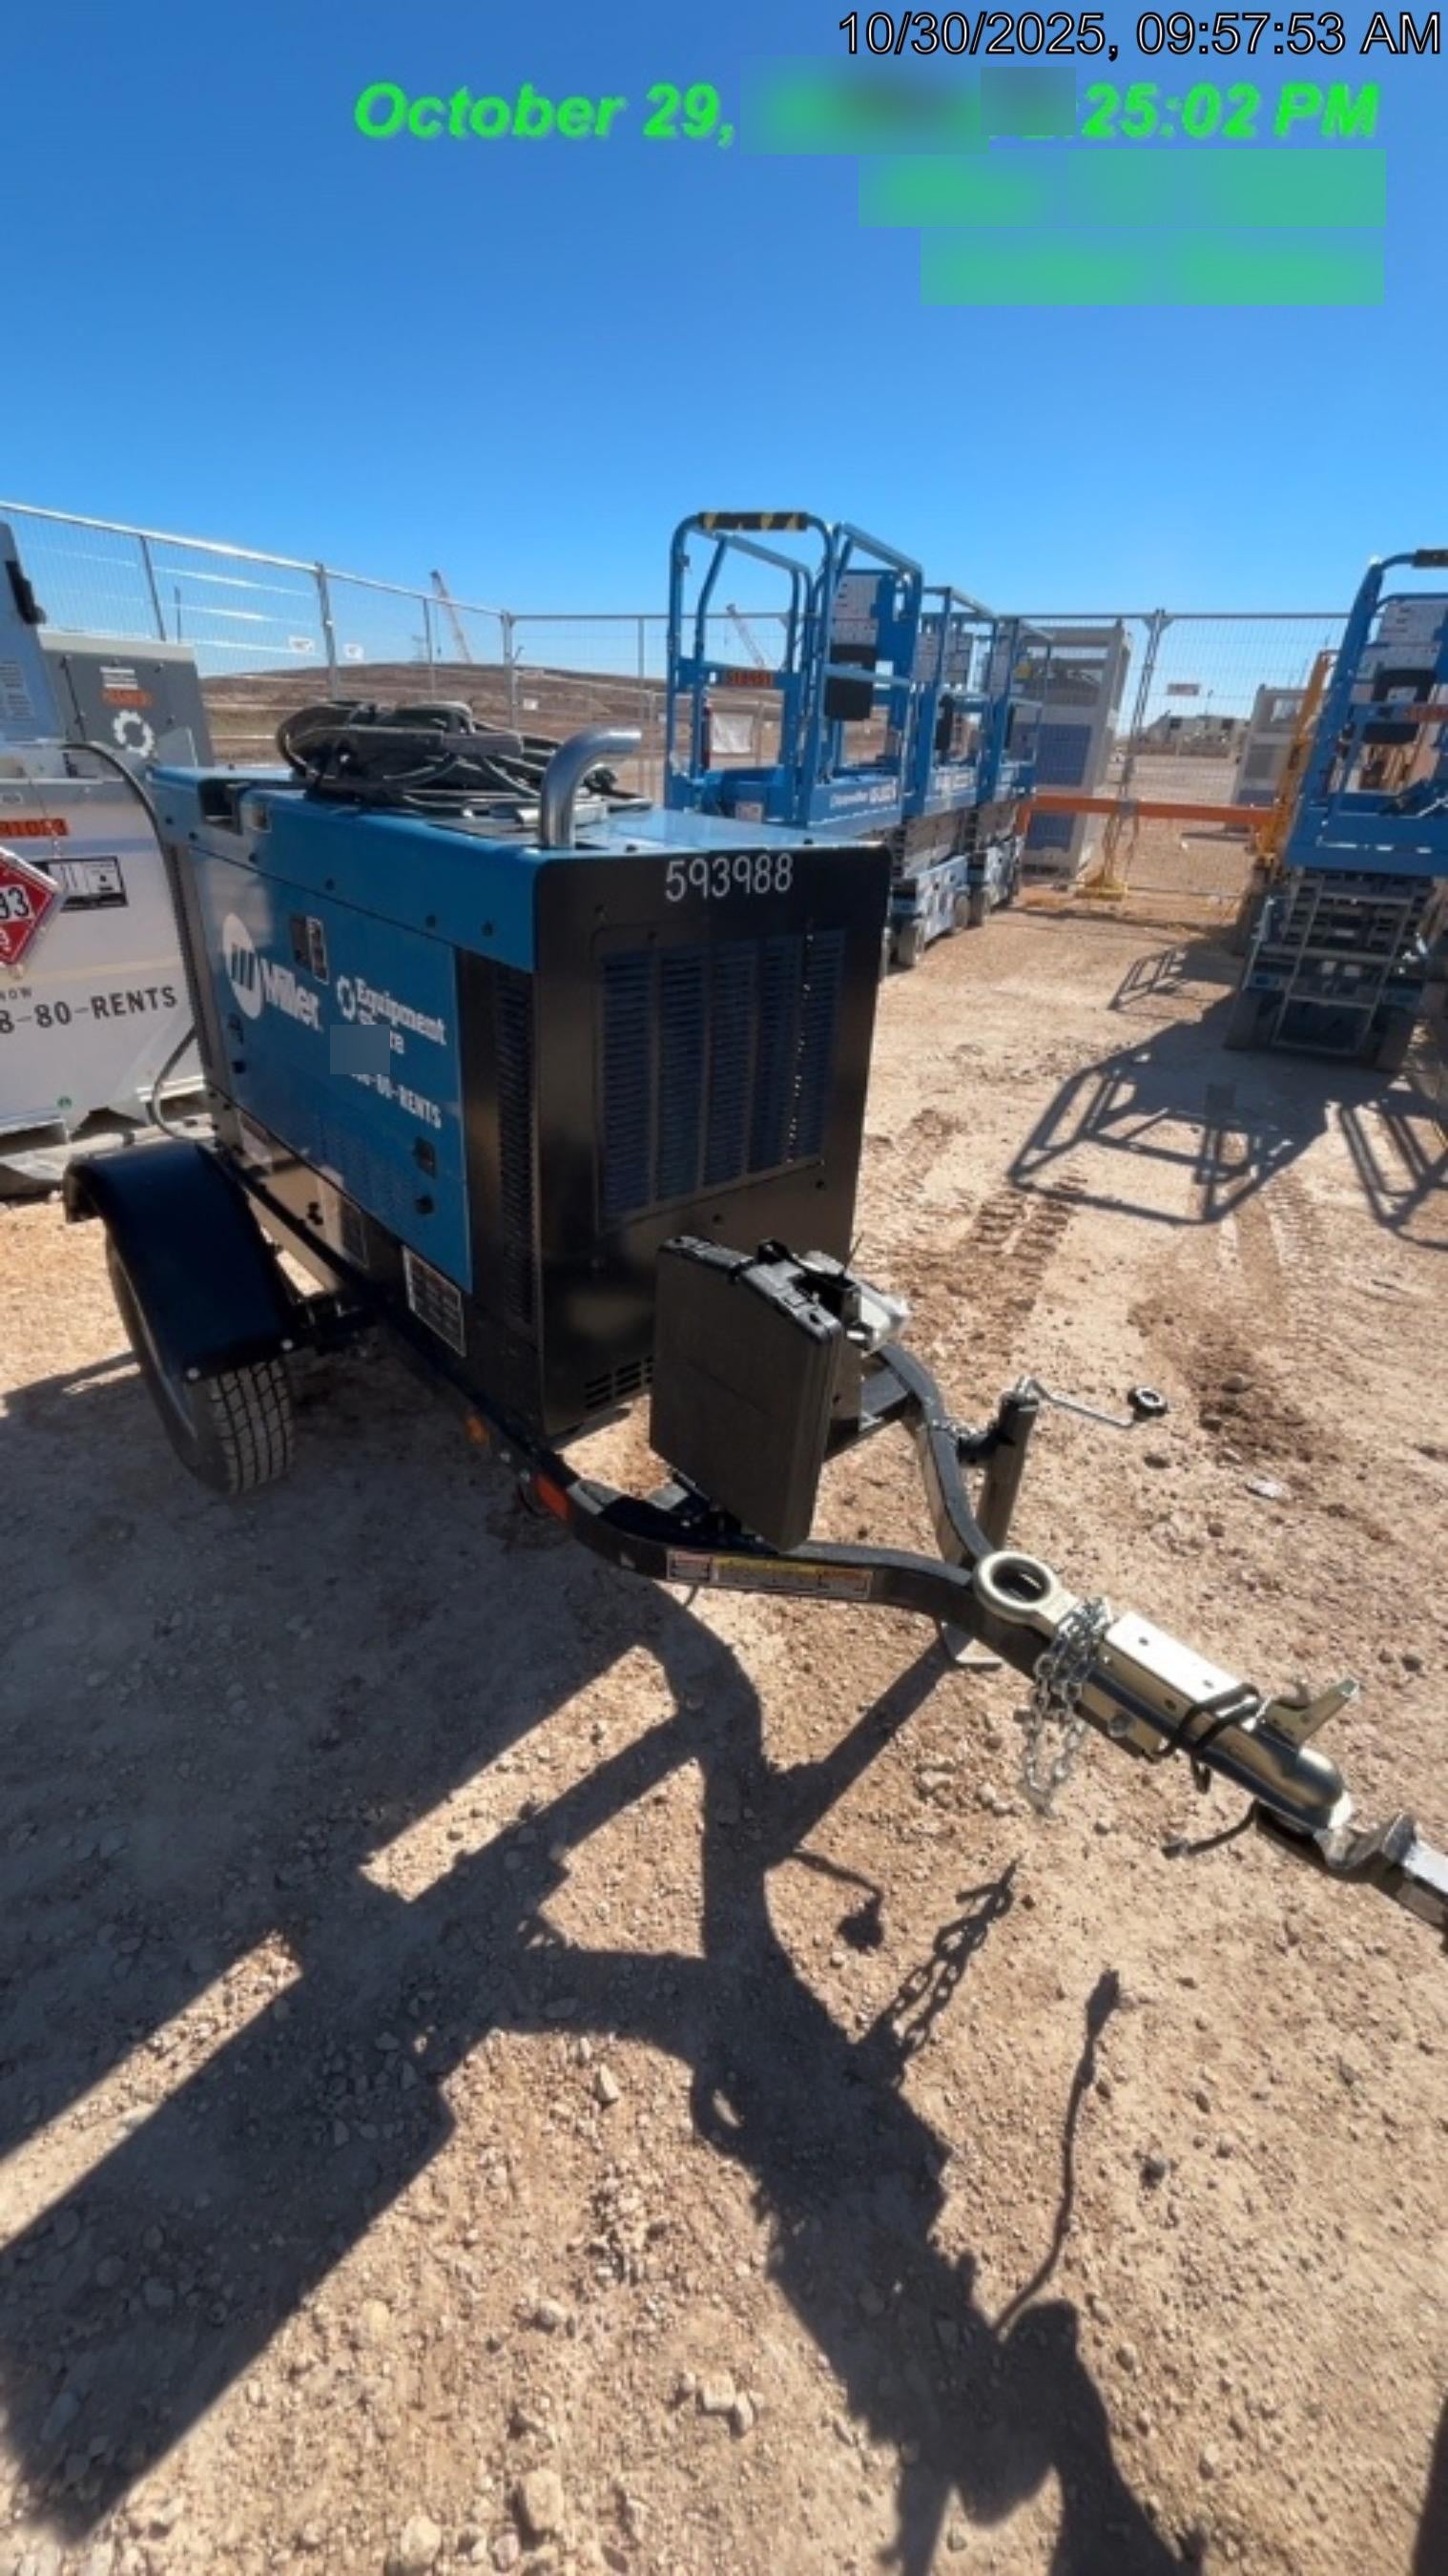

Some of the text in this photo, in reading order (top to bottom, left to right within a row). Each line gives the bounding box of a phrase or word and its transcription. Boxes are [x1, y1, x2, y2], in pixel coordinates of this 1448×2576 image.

[666, 852, 794, 902] 593988
[260, 957, 321, 1032] Miller
[355, 977, 447, 1047] Equipment
